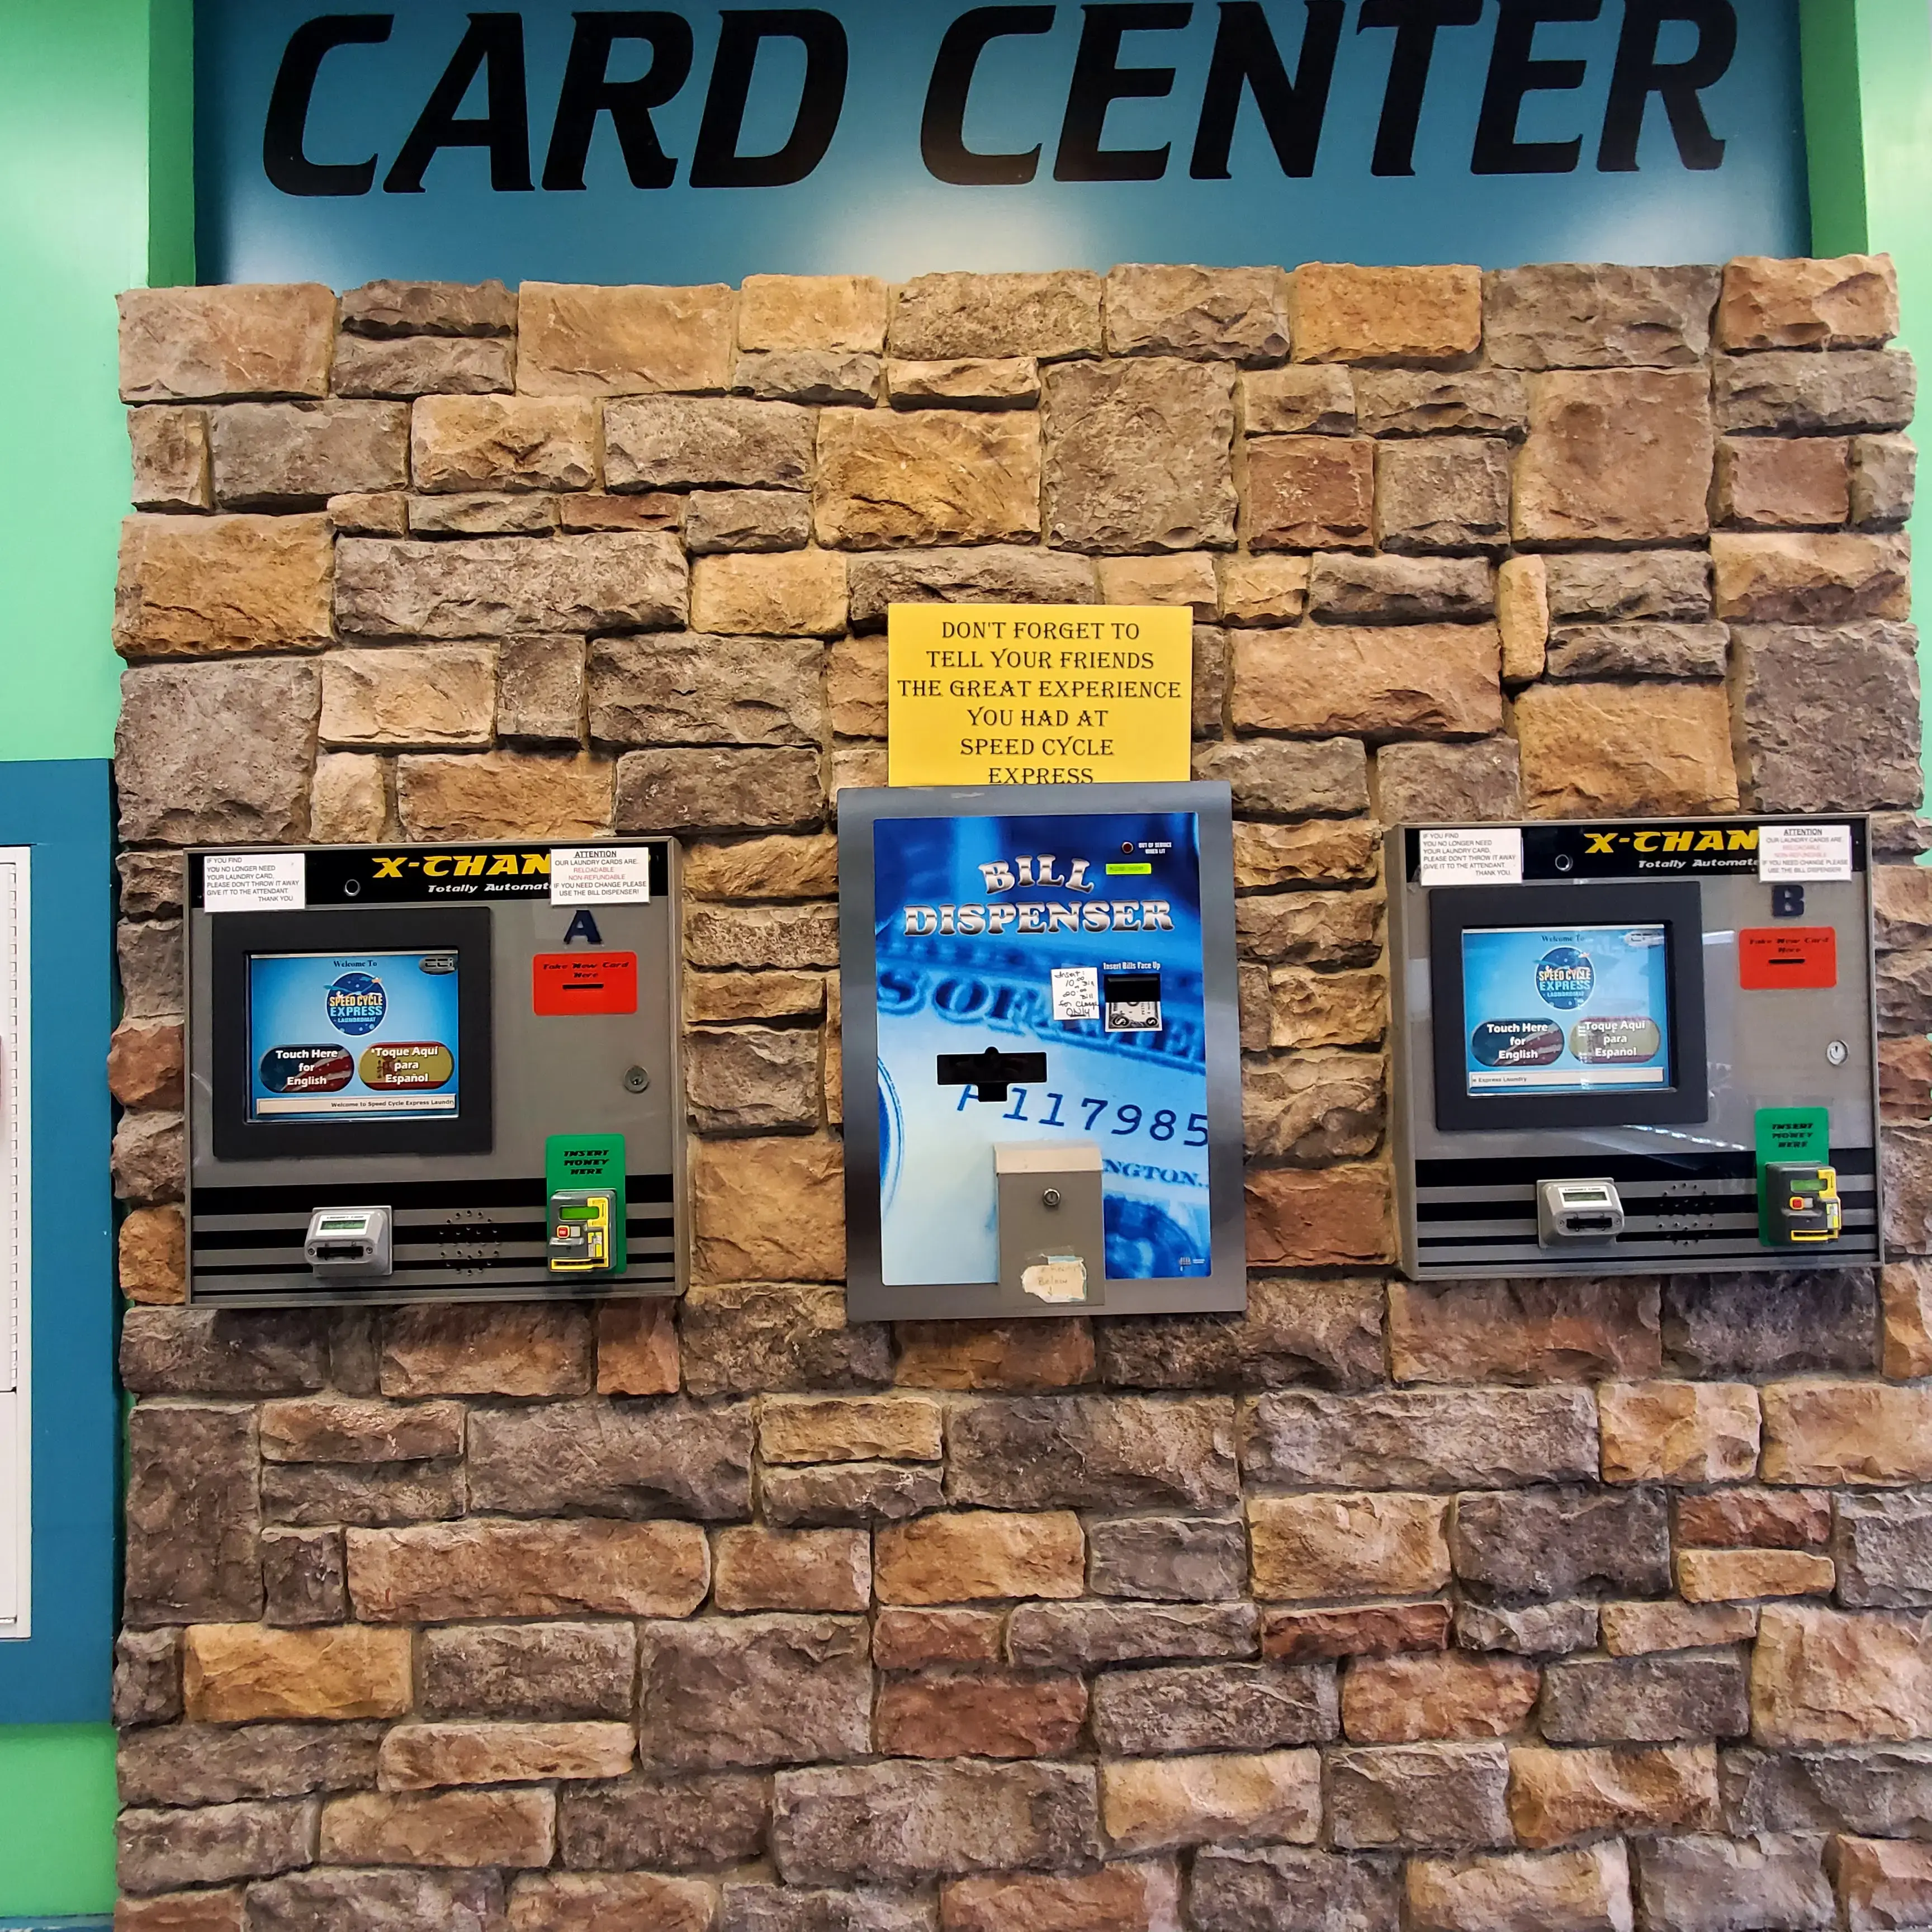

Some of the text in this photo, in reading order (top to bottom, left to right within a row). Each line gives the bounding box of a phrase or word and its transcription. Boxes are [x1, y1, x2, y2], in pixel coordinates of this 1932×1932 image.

[262, 0, 1737, 197] CARD CENTER
[941, 622, 1140, 640] DON'T FORGET TO
[926, 648, 1155, 669] TELL YOUR FRIENDS
[897, 680, 1181, 699] THE GREAT EXPERIENCE
[967, 706, 1109, 727] YOU HAD AT
[960, 736, 1114, 756] SPEED CYCLE
[988, 768, 1094, 785] EXPRESS
[1639, 859, 1686, 869] Totally
[978, 854, 1095, 894] BILL
[428, 884, 478, 893] Totally
[1772, 885, 1804, 917] B
[903, 899, 1175, 936] DISPENSER
[564, 910, 602, 944] A
[1152, 961, 1161, 970] Up
[1538, 970, 1590, 981] SPEED CYCLE
[1540, 981, 1590, 991] EXPRESS
[329, 996, 382, 1006] SPEED CYCLE
[330, 1006, 382, 1017] EXPRESS
[1487, 1024, 1548, 1033] Touch Here
[1585, 1021, 1617, 1033] Toque
[1510, 1037, 1526, 1045] for
[1603, 1035, 1627, 1044] para
[276, 1049, 338, 1059] Touch Here
[375, 1048, 410, 1058] Toque
[1499, 1050, 1538, 1061] English
[1595, 1047, 1637, 1058] Español
[299, 1063, 314, 1072] for
[394, 1063, 419, 1071] para
[287, 1077, 326, 1087] English
[385, 1074, 428, 1085] Español
